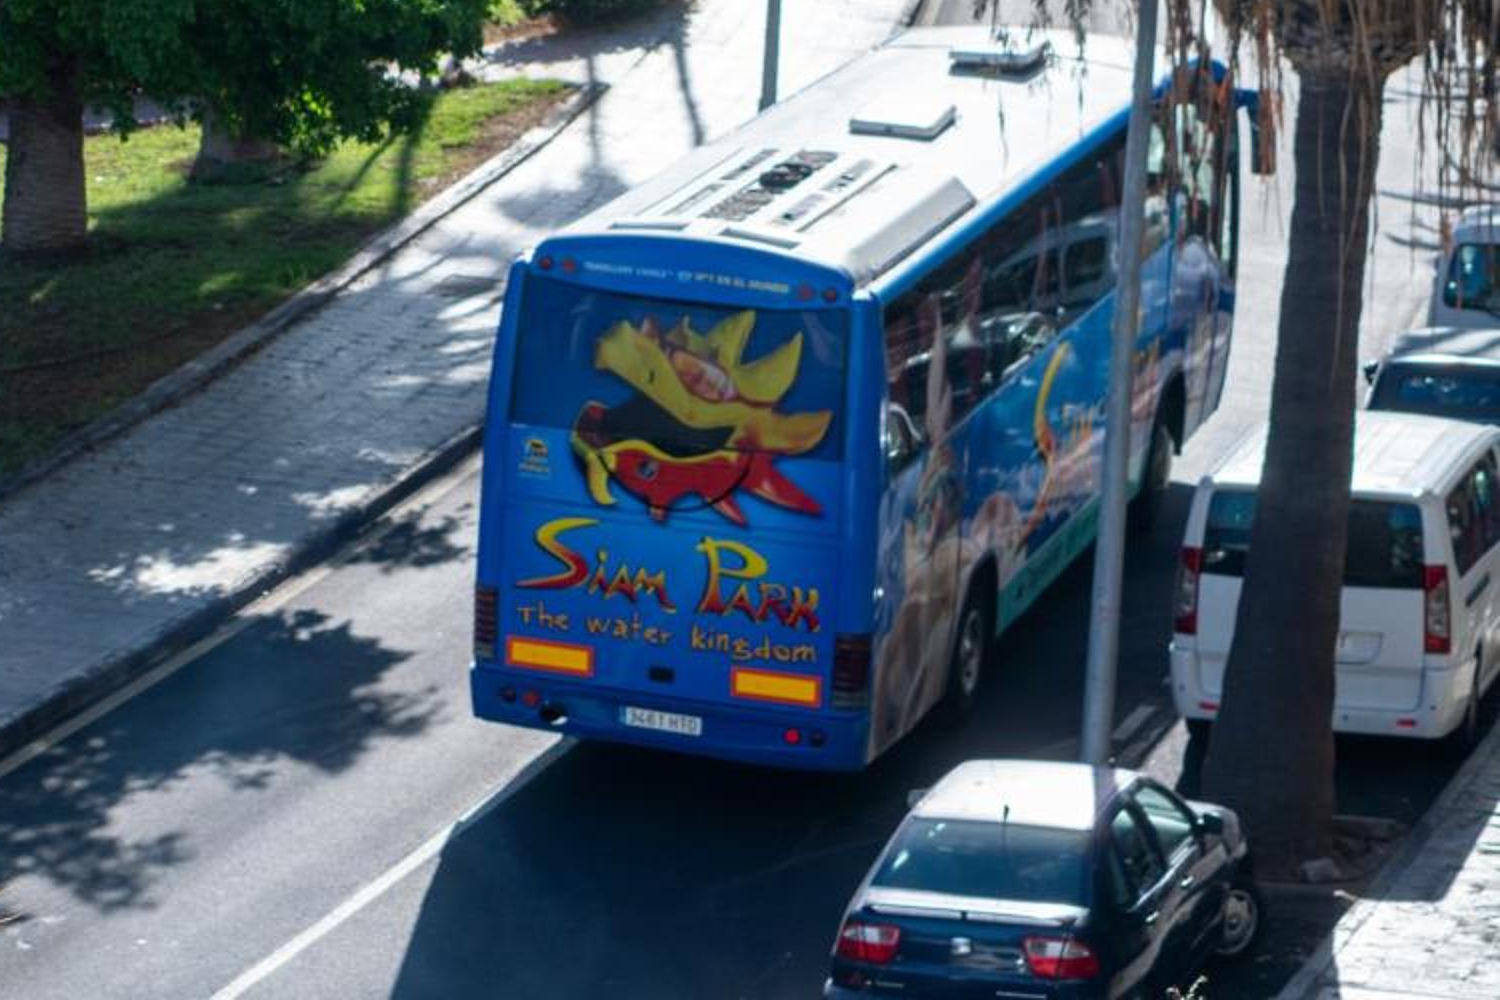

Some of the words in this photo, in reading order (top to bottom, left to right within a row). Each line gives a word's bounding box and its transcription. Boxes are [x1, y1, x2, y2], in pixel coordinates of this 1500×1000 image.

[696, 536, 821, 633] PARK
[516, 600, 570, 631] The
[587, 613, 671, 645] water
[691, 626, 817, 662] kingdom
